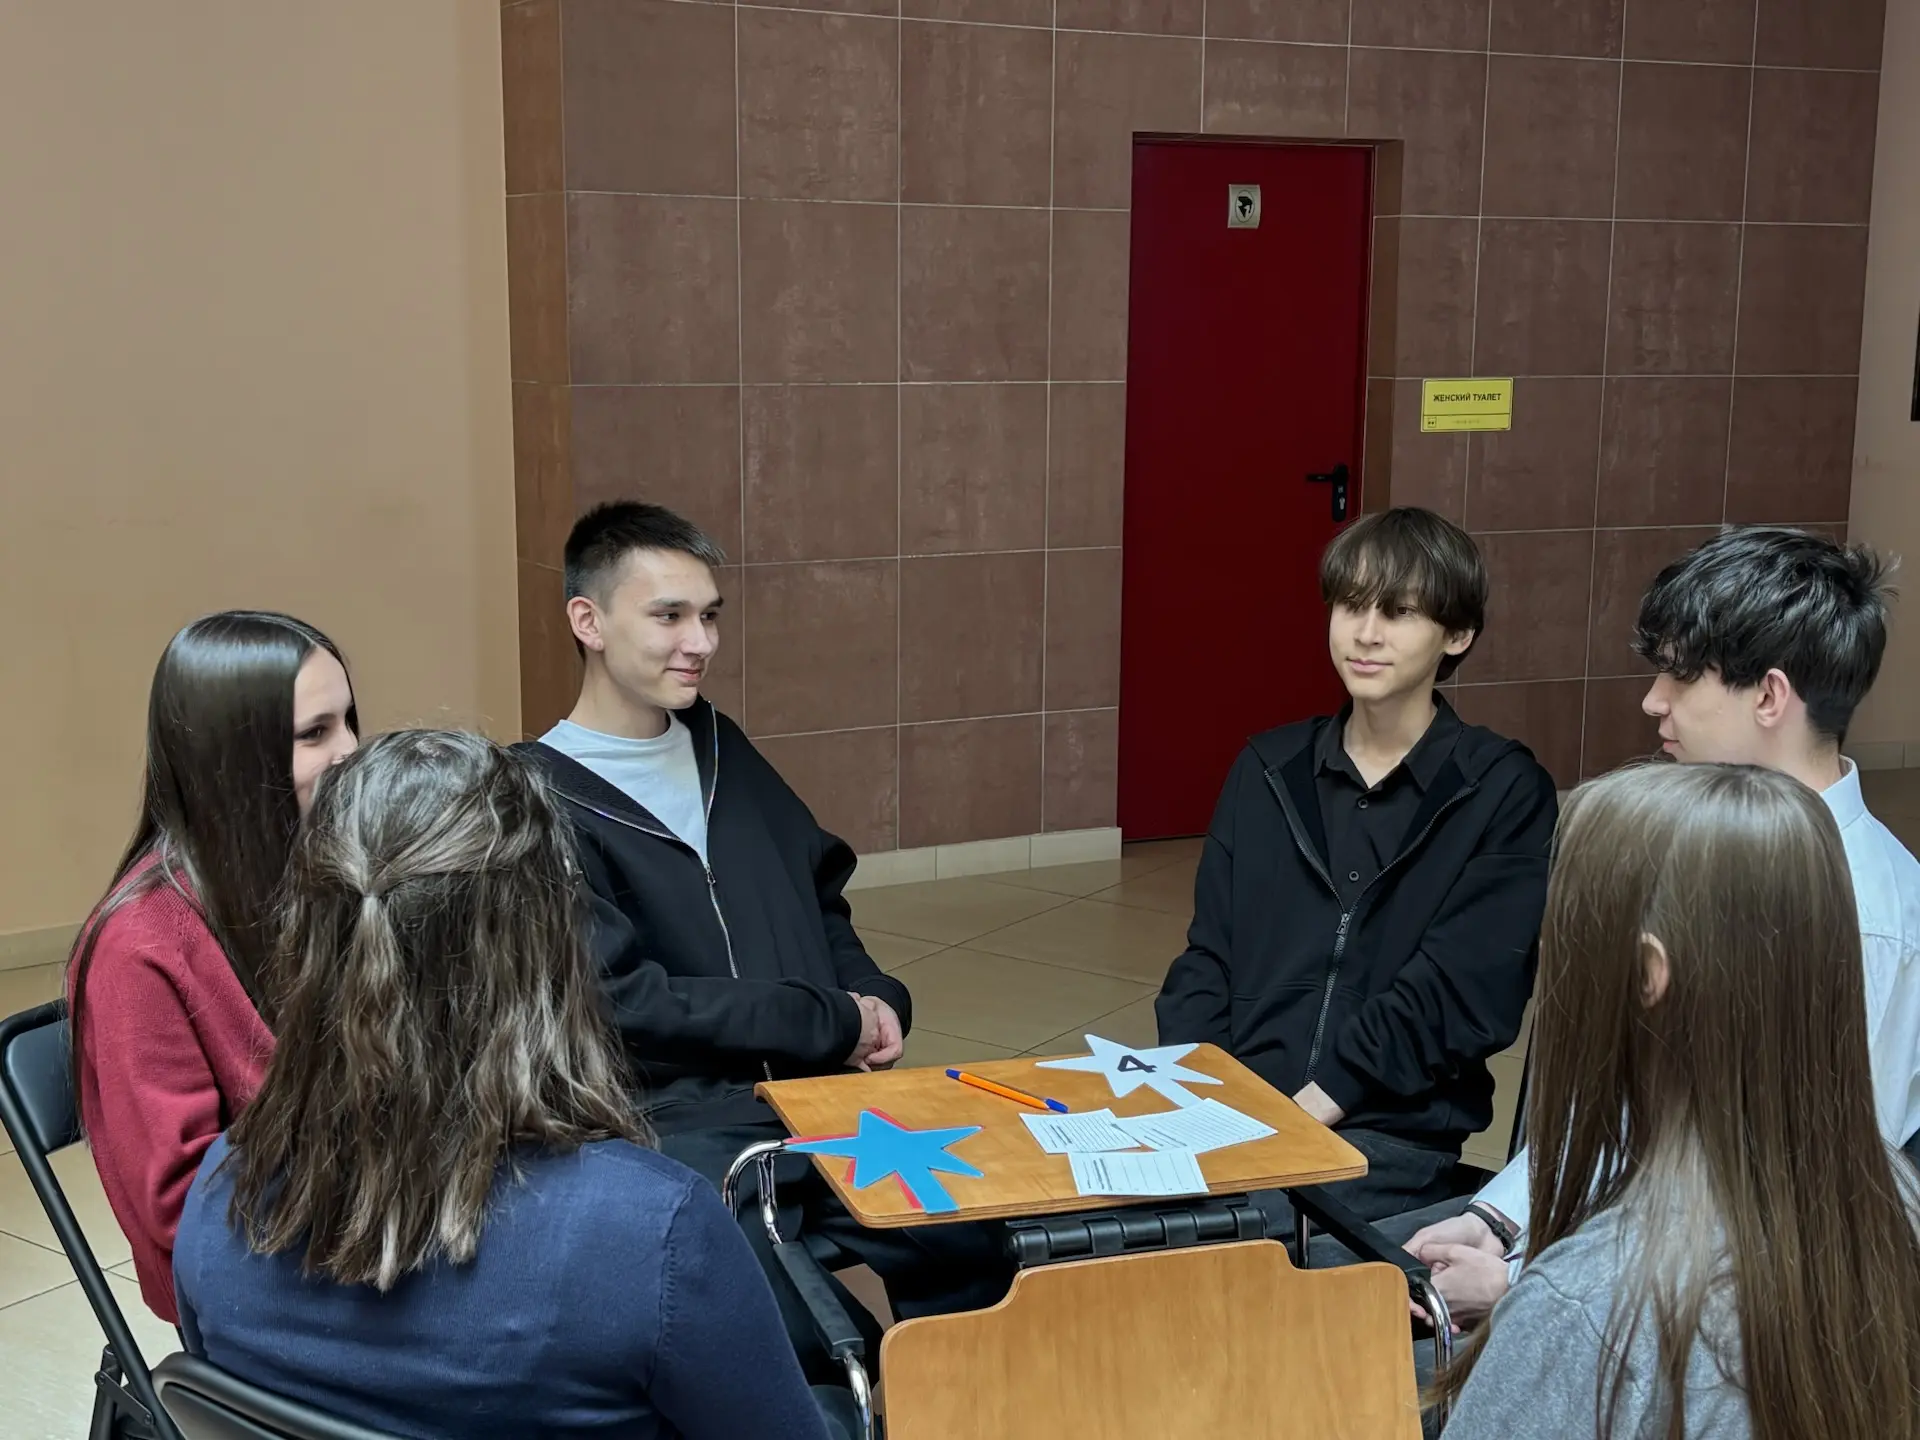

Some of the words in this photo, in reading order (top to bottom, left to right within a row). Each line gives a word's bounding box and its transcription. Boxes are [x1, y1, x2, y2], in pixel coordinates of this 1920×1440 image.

[1432, 392, 1470, 402] ЖЕНСКИЙ
[1472, 392, 1502, 401] ТУАЛЕТ
[1117, 1054, 1158, 1074] 4
